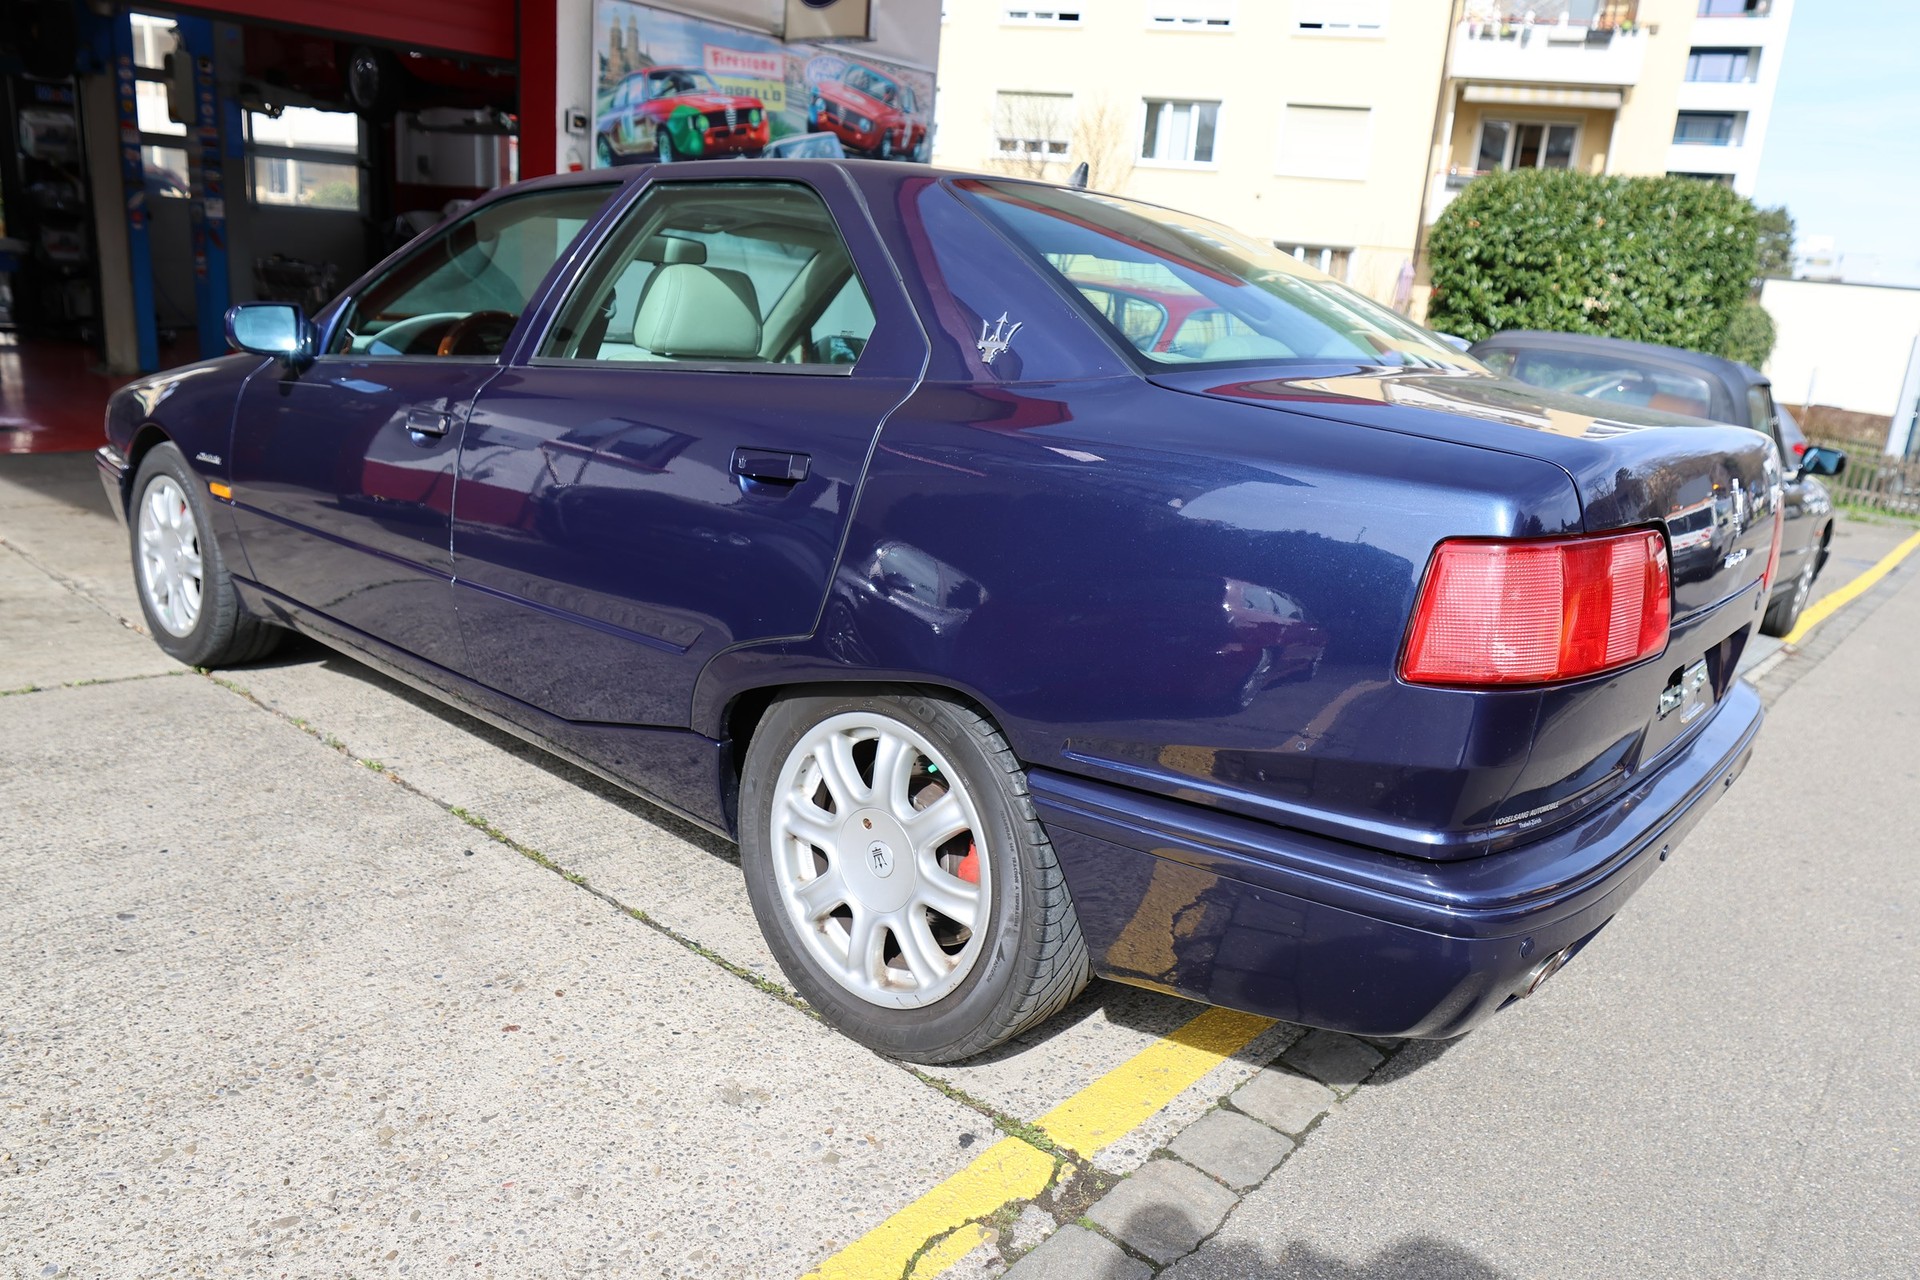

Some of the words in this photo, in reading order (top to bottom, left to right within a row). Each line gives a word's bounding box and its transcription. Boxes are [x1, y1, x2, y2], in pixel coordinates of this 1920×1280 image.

[711, 50, 777, 71] Firestone
[1495, 811, 1530, 826] VOGELSANG
[1530, 801, 1560, 816] AUTOMOBILE
